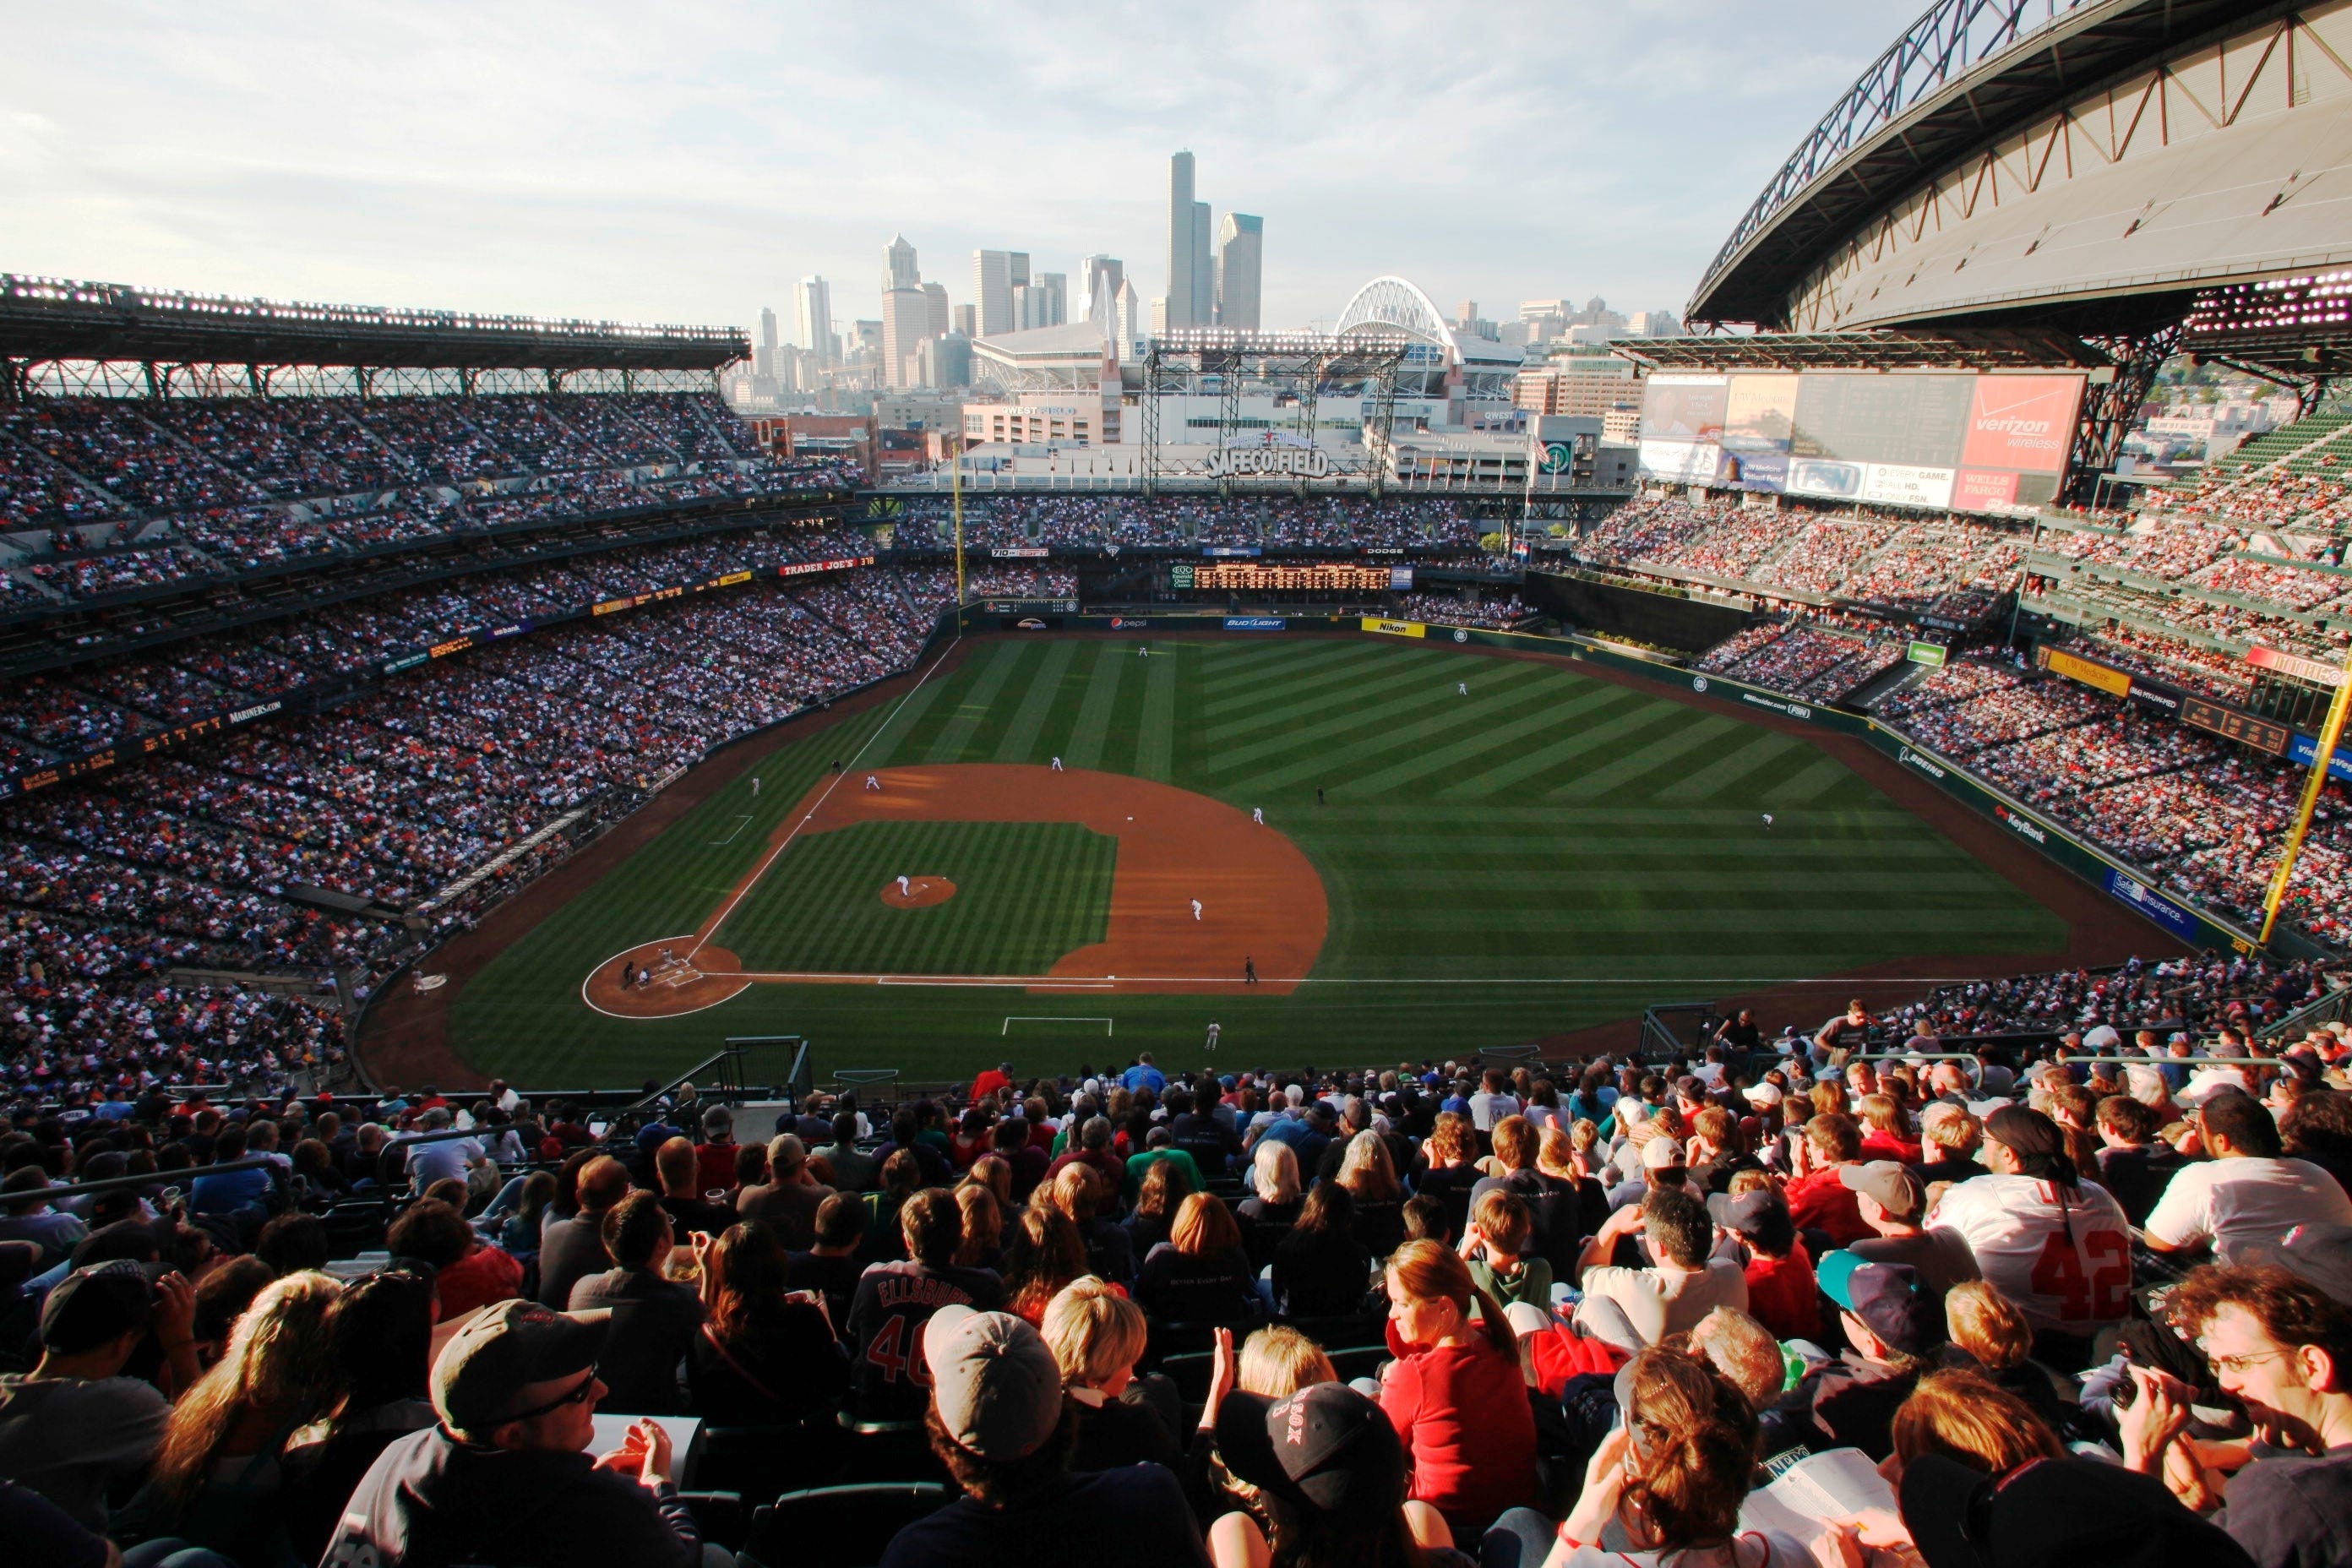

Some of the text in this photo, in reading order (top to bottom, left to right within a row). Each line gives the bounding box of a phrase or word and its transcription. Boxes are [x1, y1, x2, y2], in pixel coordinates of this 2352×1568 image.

[1001, 406, 1075, 415] QWEST FIELD
[1484, 411, 1514, 421] QWEST
[1976, 416, 2050, 436] verizon
[2007, 437, 2060, 449] wireless
[1207, 449, 1329, 479] SAFECO FIELD
[1744, 473, 1766, 482] Patient
[1801, 465, 1853, 492] FSN
[1919, 471, 1949, 481] GAME.
[1965, 474, 2009, 486] WELLS
[1904, 482, 1919, 491] HD.
[1964, 485, 2006, 496] FARGO
[1886, 492, 1929, 503] ONLY FSN.
[785, 556, 874, 575] TRADER JOE'S 378
[1124, 619, 1146, 628] pepsi
[1380, 623, 1406, 633] Nikon
[1926, 617, 1955, 629] MARINERS
[2066, 658, 2110, 683] UW Medicine
[229, 701, 281, 724] MARINERS.COM
[1909, 754, 1945, 778] BOEING
[2007, 813, 2045, 844] KeyBank
[2115, 876, 2142, 898] Safeco
[2142, 891, 2181, 921] Insurance
[2230, 939, 2248, 954] 326
[2030, 1230, 2132, 1321] 42
